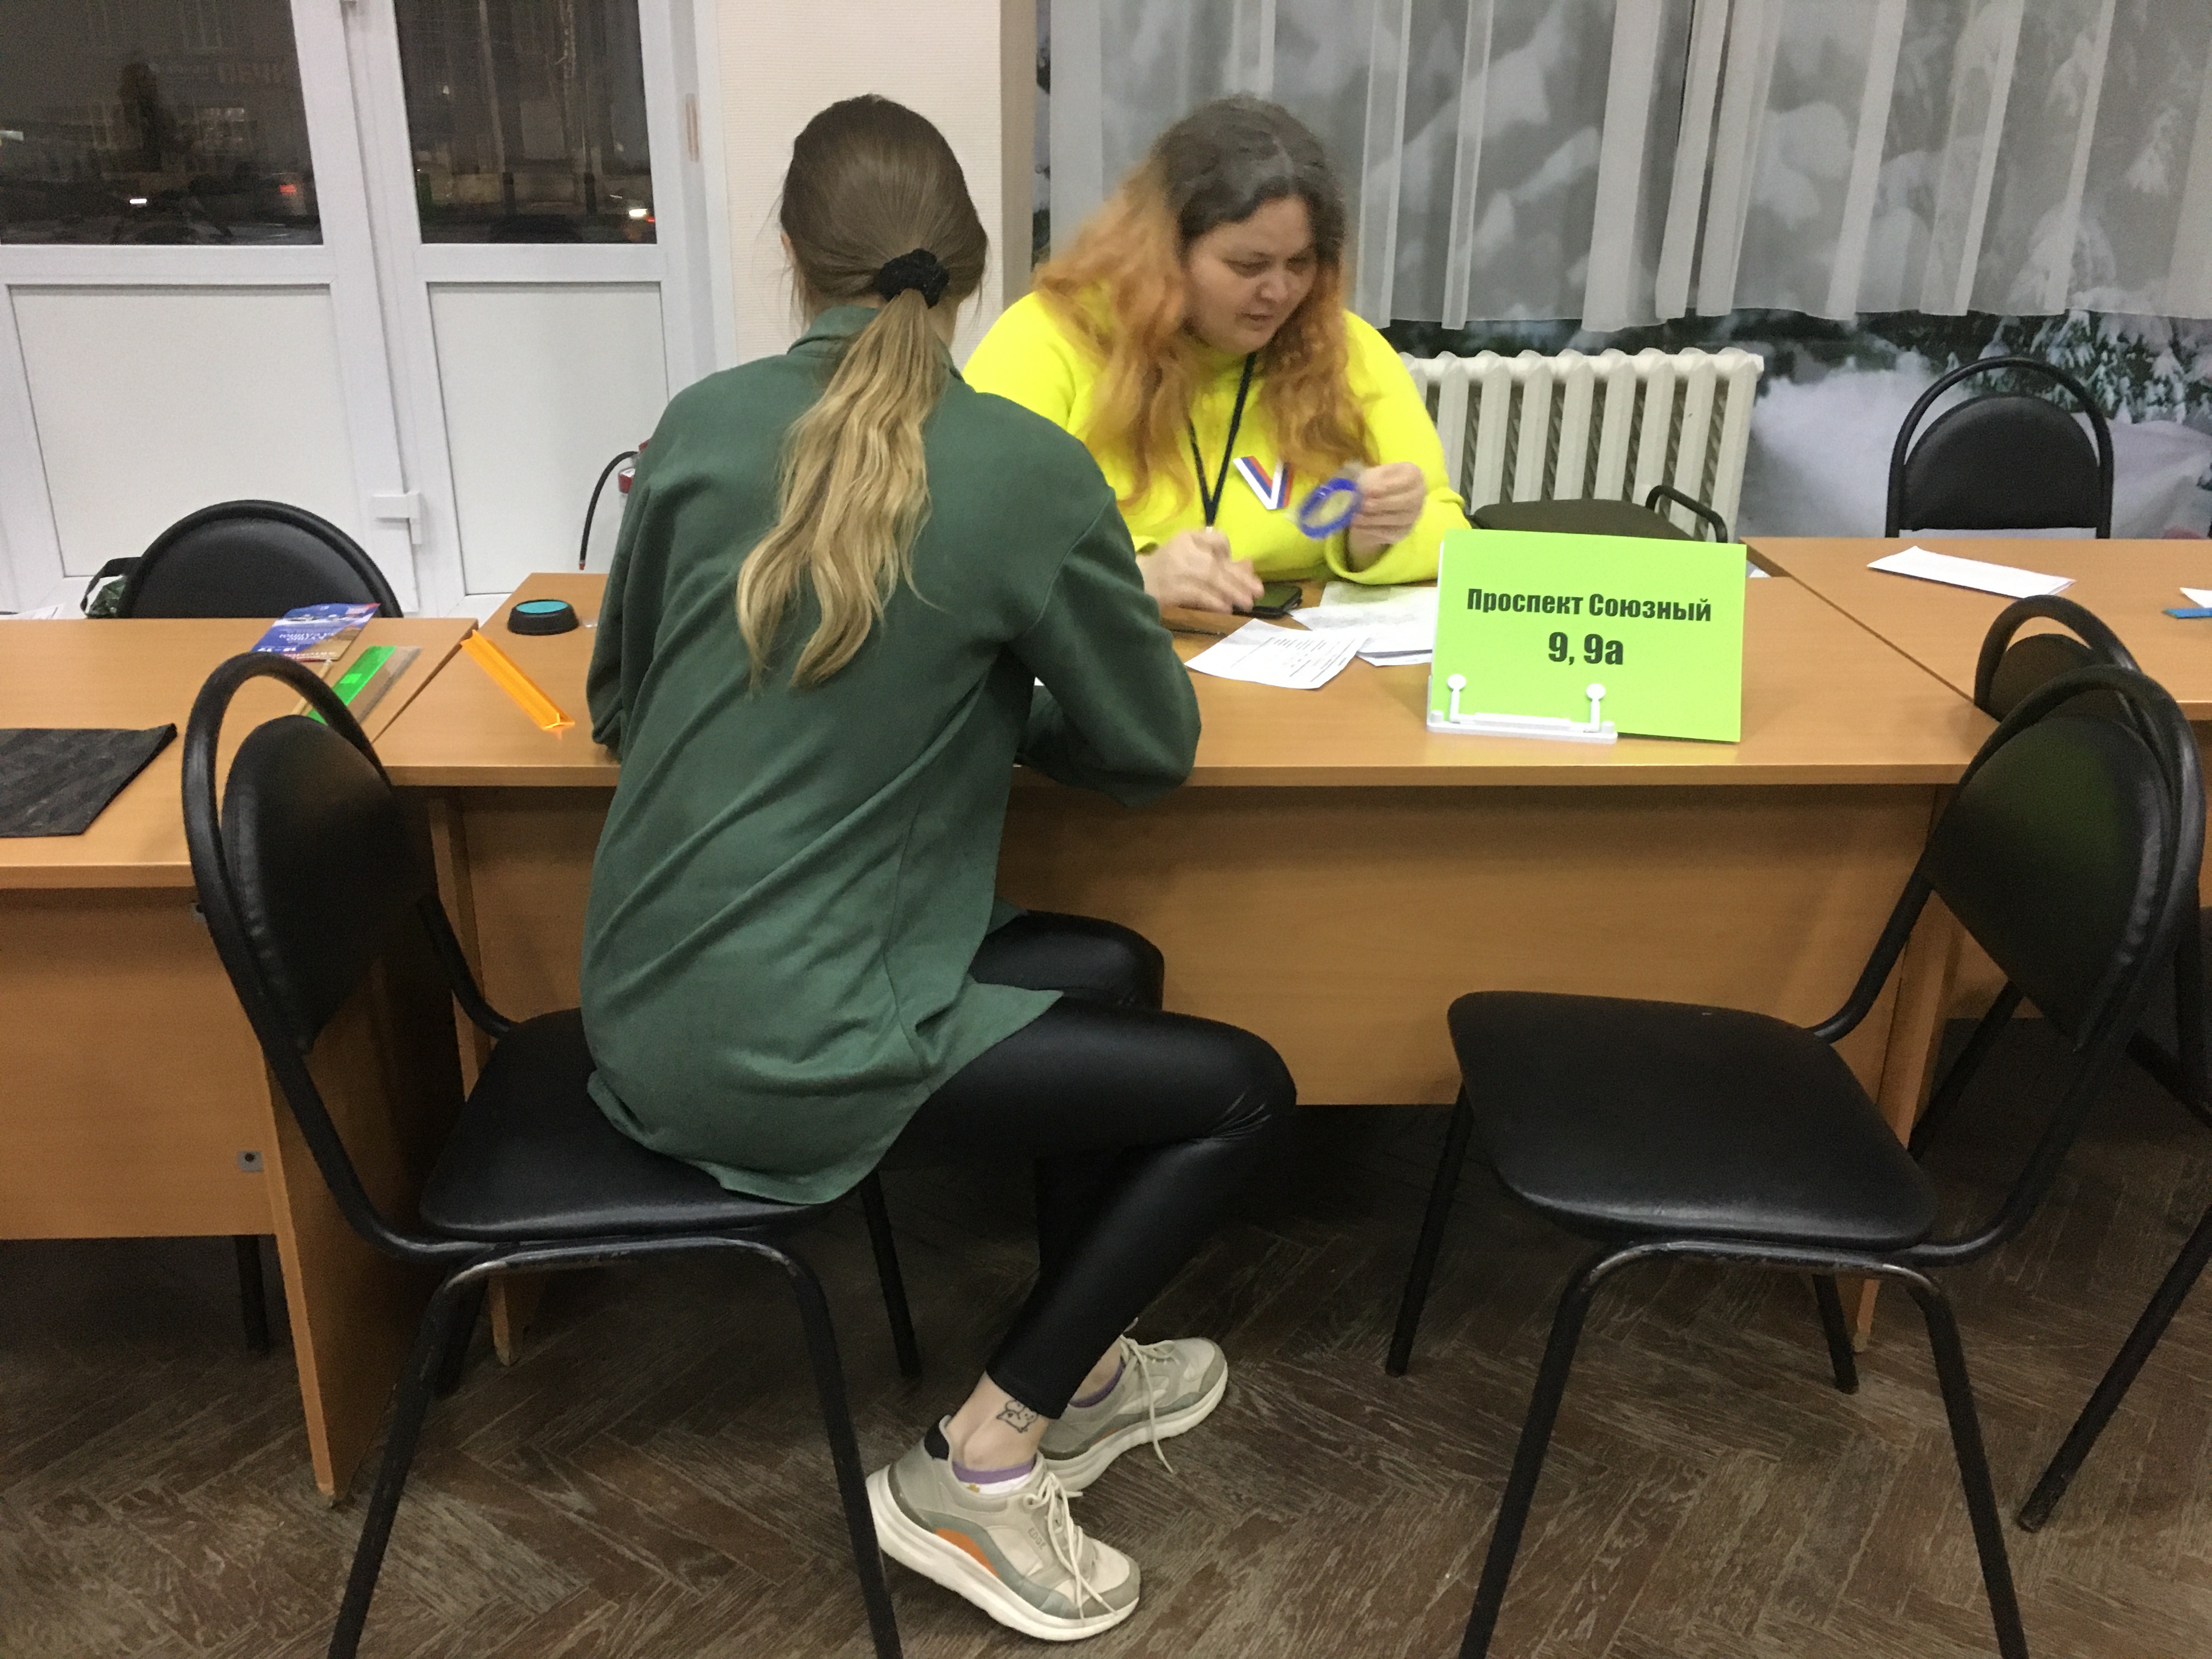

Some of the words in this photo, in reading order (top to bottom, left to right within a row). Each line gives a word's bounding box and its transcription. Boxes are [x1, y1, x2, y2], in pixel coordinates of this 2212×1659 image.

[1467, 588, 1583, 614] Проспект
[1589, 593, 1711, 622] Союзный
[1548, 631, 1575, 665] 9,
[1583, 633, 1624, 665] 9а
[1028, 1527, 1046, 1550] EDGE
